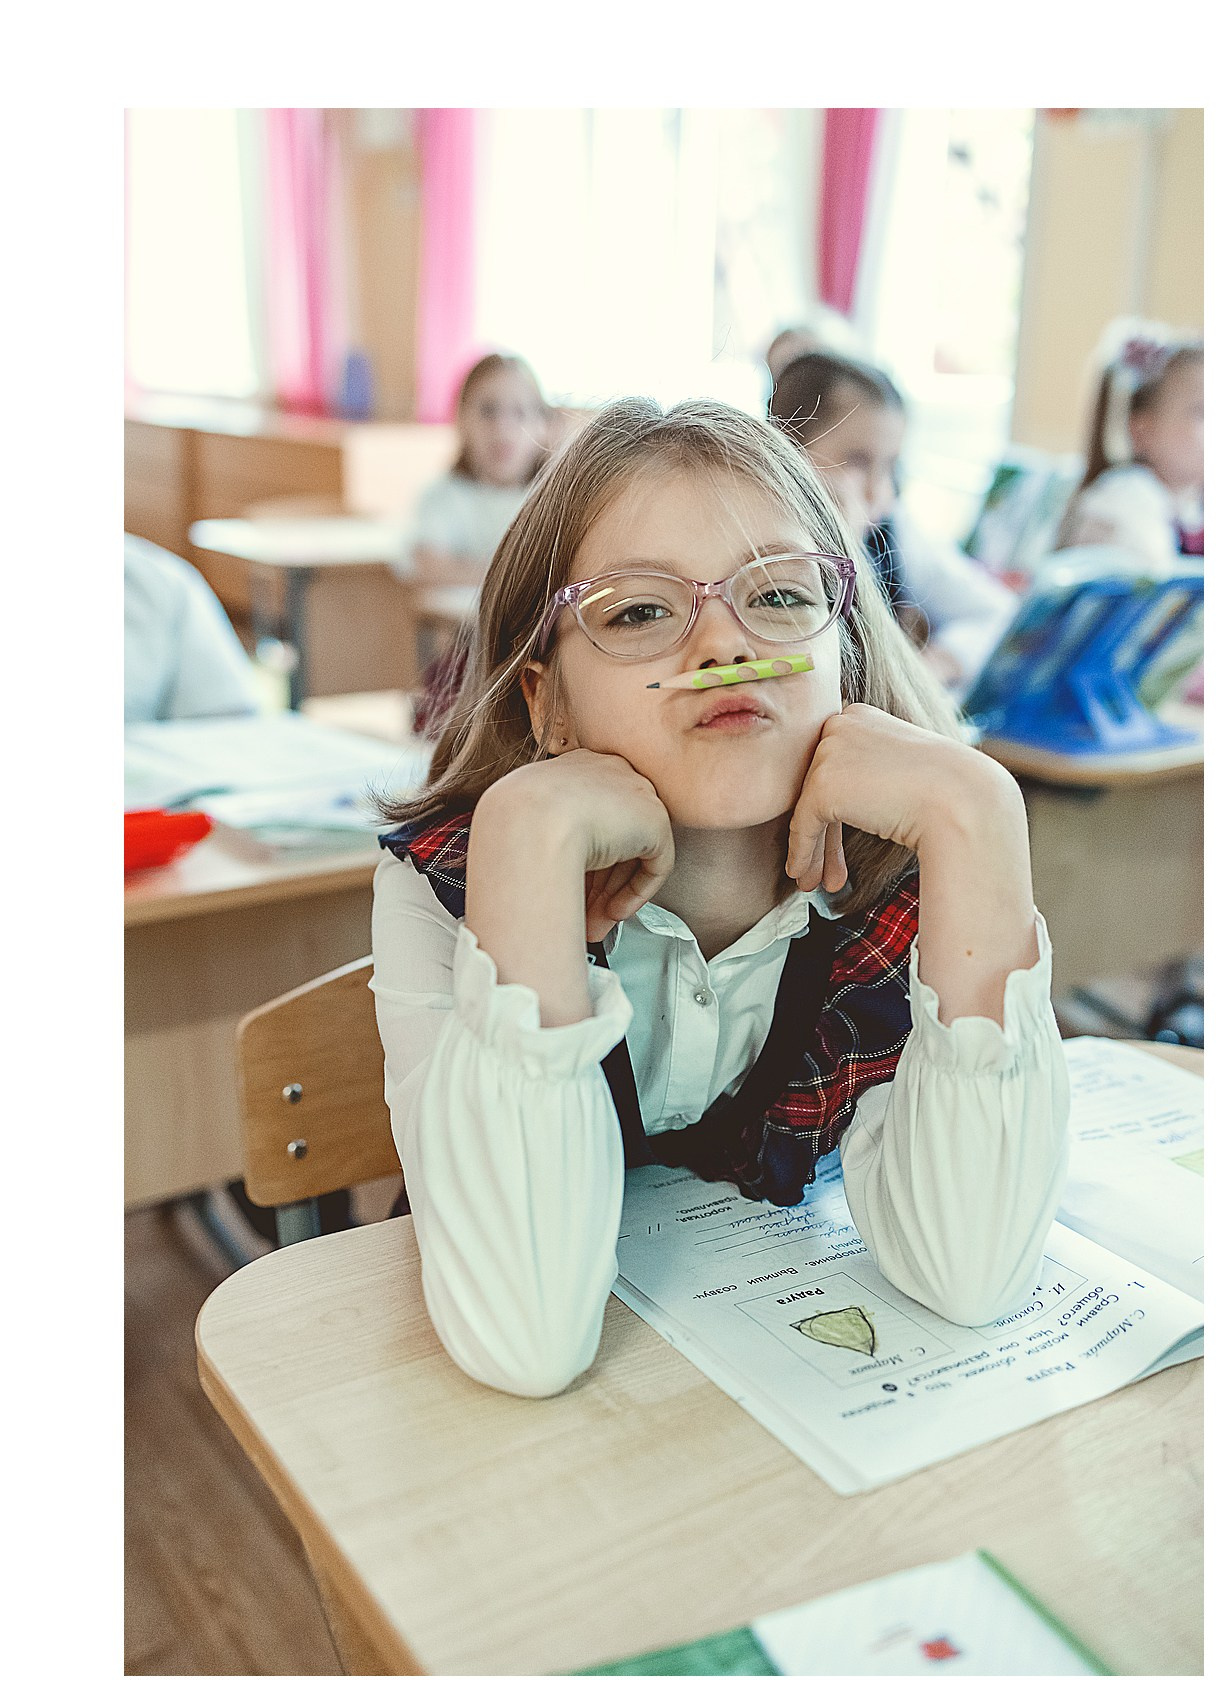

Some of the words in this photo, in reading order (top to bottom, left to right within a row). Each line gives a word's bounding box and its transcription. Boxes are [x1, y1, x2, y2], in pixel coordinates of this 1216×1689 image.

[675, 1195, 739, 1215] правильно.
[675, 1206, 733, 1224] короткая,
[804, 1247, 868, 1267] отворение.
[747, 1267, 798, 1286] Выпиши
[693, 1284, 738, 1301] созвуч-
[776, 1287, 825, 1305] Радуга
[1058, 1286, 1104, 1327] общего?
[1077, 1294, 1120, 1327] Сравни
[1026, 1329, 1054, 1342] Чем
[1027, 1332, 1070, 1356] модели
[998, 1341, 1020, 1353] они
